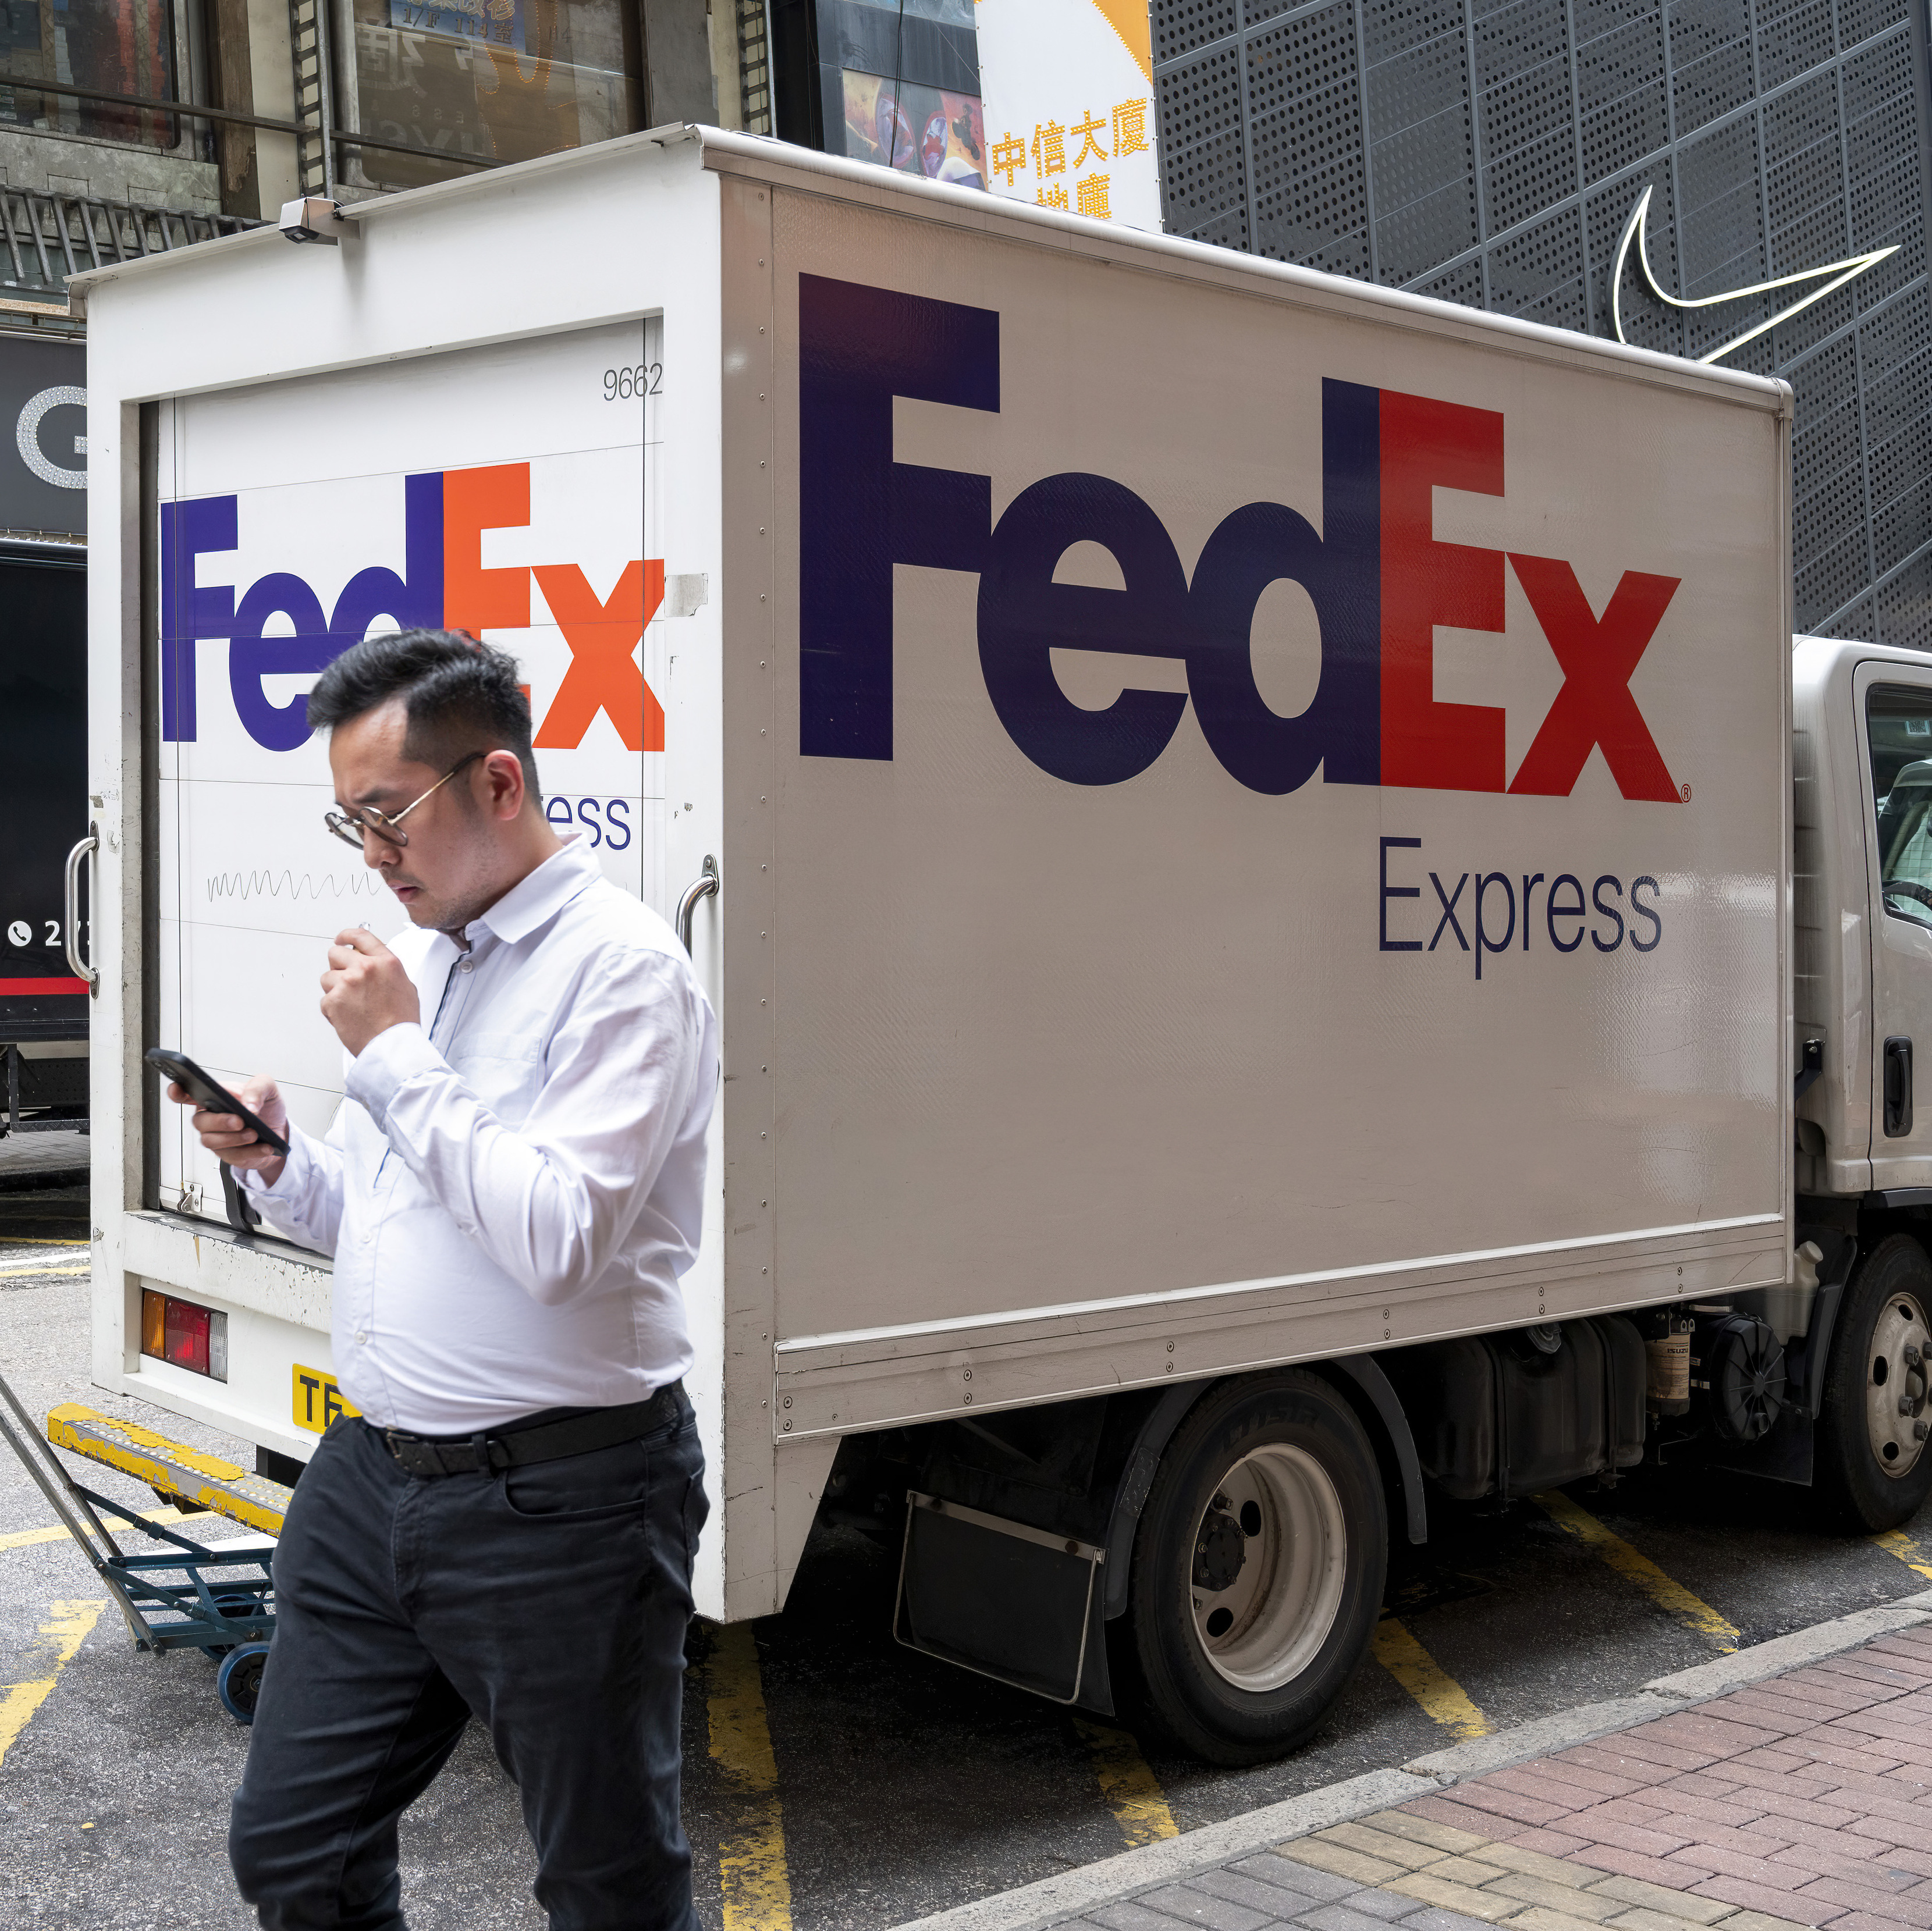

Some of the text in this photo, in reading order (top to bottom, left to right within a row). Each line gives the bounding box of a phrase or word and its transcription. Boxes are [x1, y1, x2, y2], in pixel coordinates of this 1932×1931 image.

[403, 7, 440, 28] 1/F
[992, 97, 1150, 187] 中信大廈
[603, 362, 663, 401] 9662
[540, 795, 631, 851] ess
[1379, 836, 1662, 980] Express
